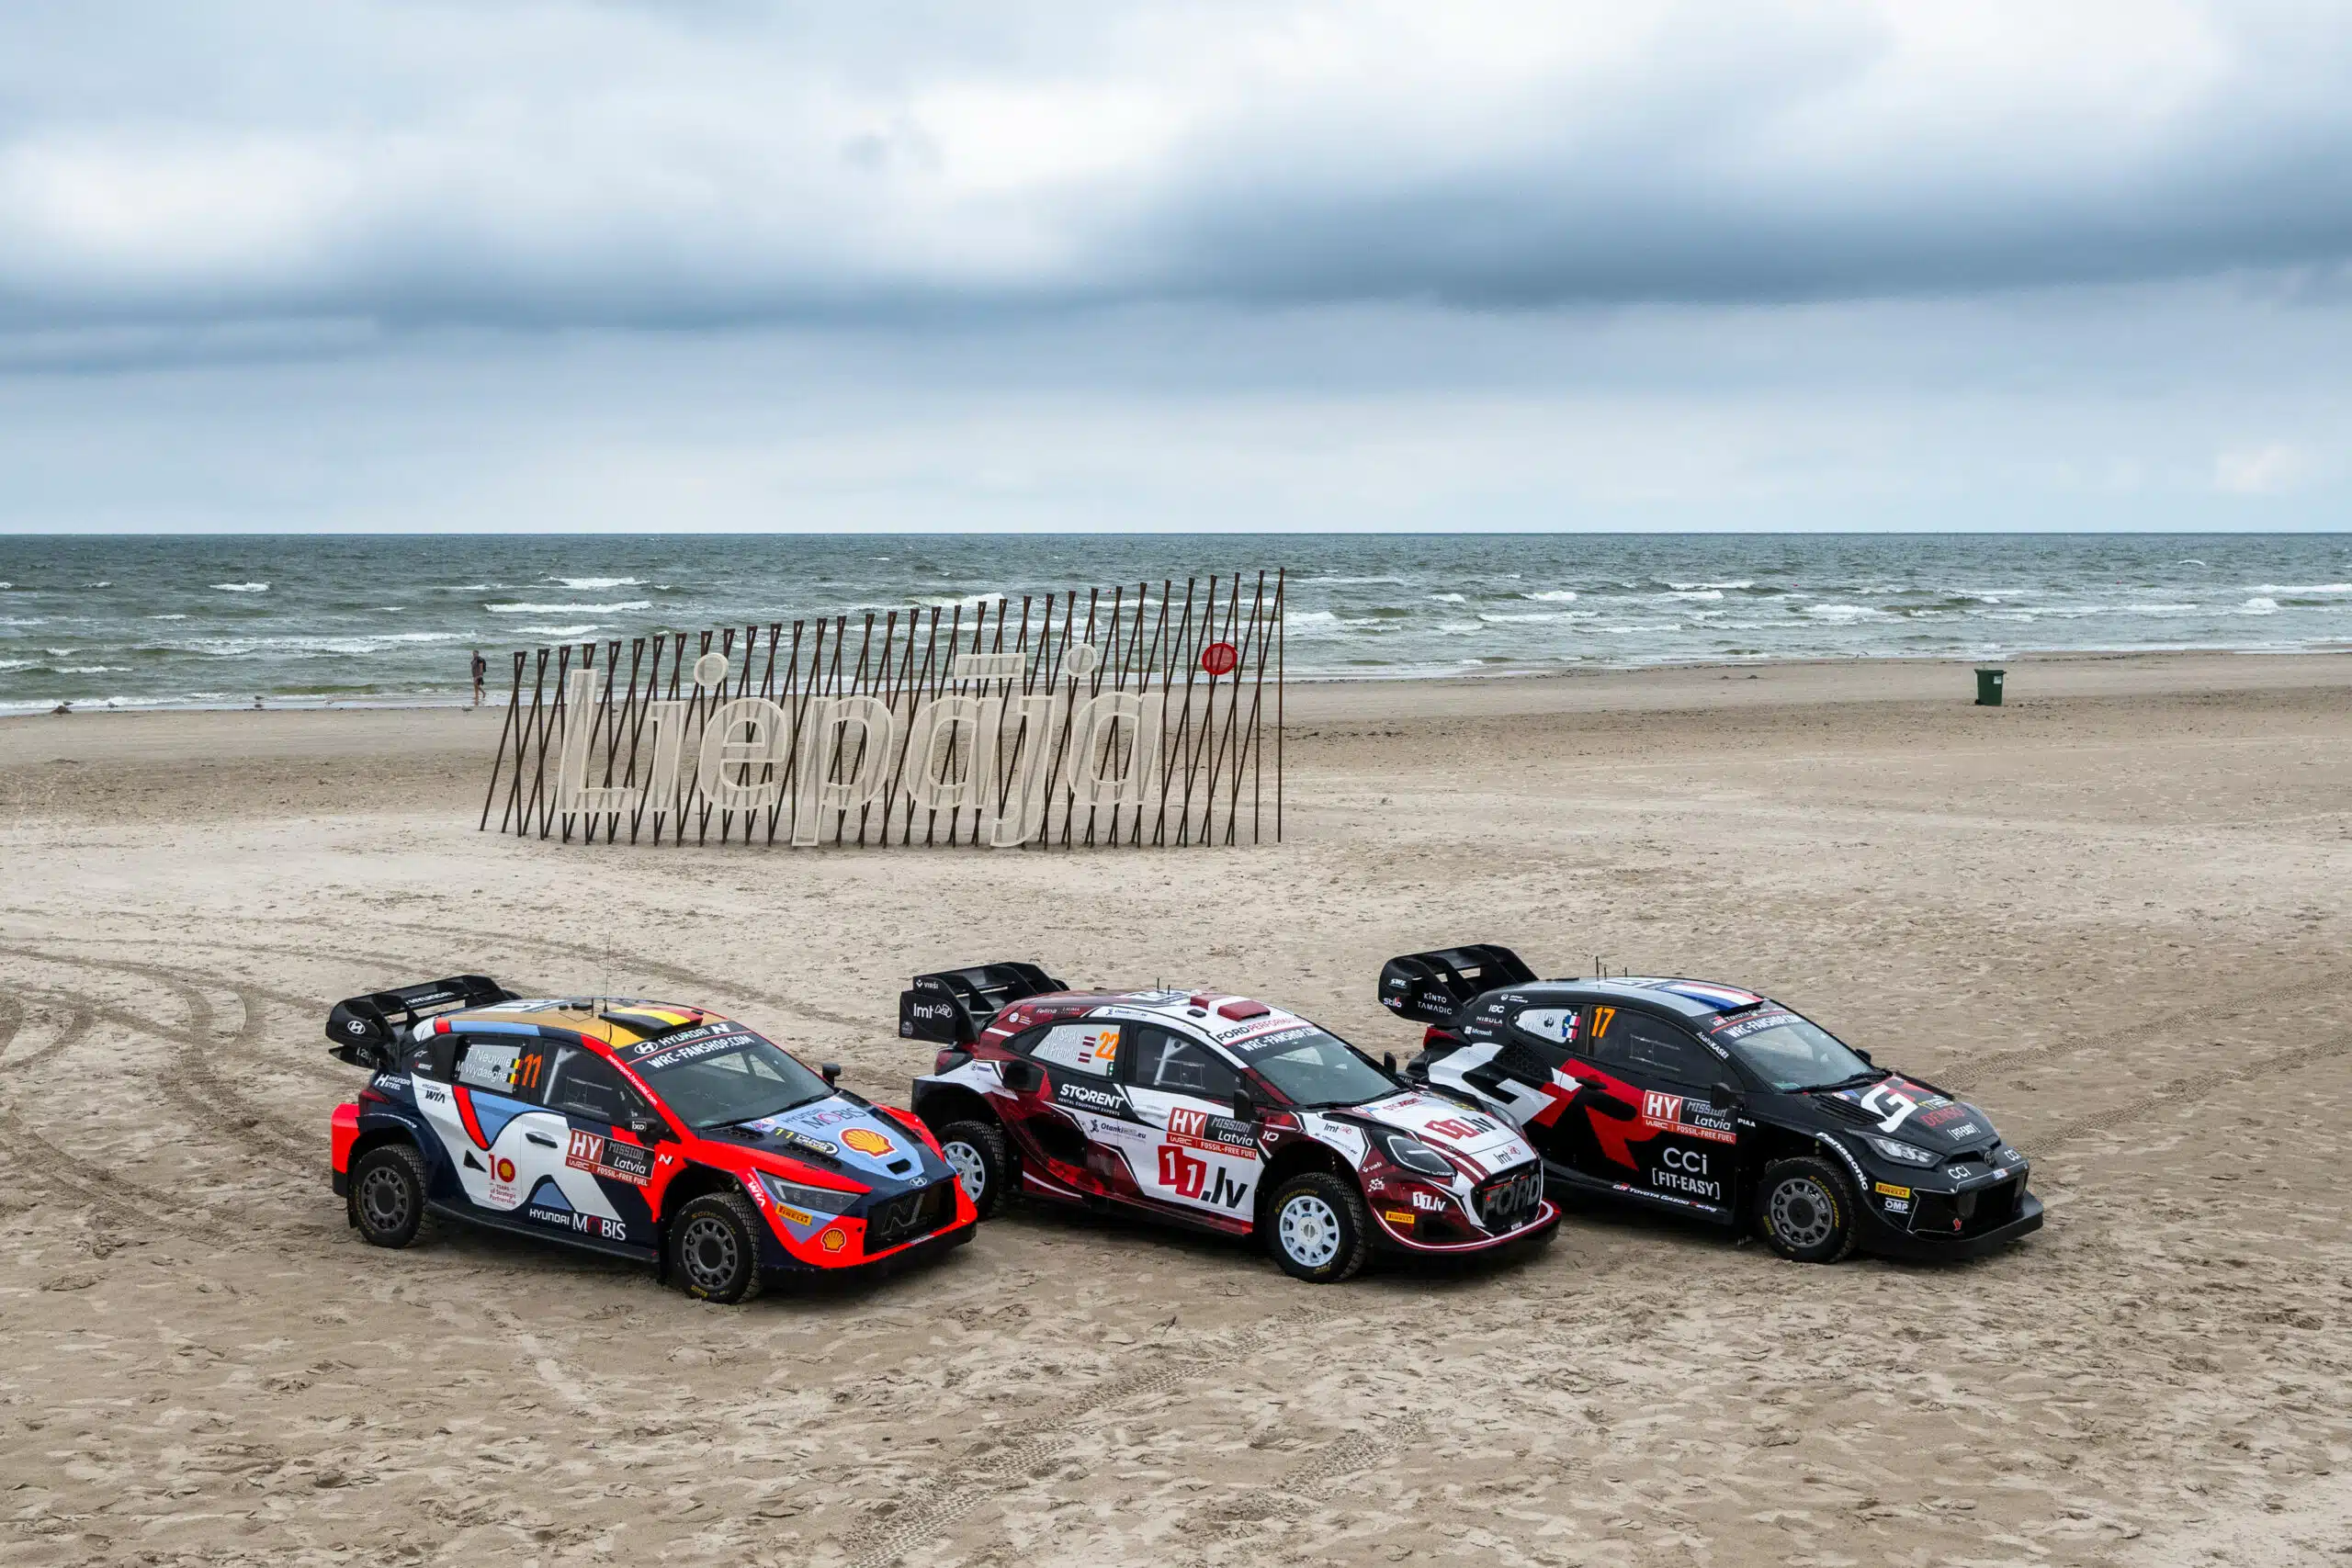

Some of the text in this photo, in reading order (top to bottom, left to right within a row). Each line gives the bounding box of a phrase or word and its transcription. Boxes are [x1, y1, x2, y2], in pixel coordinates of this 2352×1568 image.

[555, 643, 1164, 847] Liepāja
[913, 1003, 933, 1019] lmt
[1384, 997, 1402, 1008] Stilo
[1417, 1001, 1453, 1015] TAMADIC
[1476, 1016, 1503, 1024] NISULA
[1591, 1007, 1616, 1039] 17
[658, 1028, 710, 1046] HYUNDAI
[1216, 1026, 1250, 1042] FORD
[647, 1034, 755, 1068] WRC-FANSHOP.COM
[1095, 1031, 1120, 1060] 22
[476, 1050, 513, 1067] Neuville
[522, 1054, 542, 1089] 11
[606, 1055, 658, 1106] motorsport.hyundai.com
[384, 1081, 401, 1091] STEEL
[388, 1076, 412, 1087] HYUNDAI
[1060, 1084, 1124, 1110] STORENT
[1647, 1094, 1679, 1120] HY
[800, 1107, 866, 1130] MOBIS
[1171, 1109, 1204, 1135] HY
[1211, 1116, 1251, 1133] MISSION
[1694, 1114, 1731, 1131] Latvia
[1737, 1117, 1757, 1127] PIAA
[1218, 1131, 1253, 1146] Latvia
[1677, 1125, 1716, 1140] FOSSIL-FREE
[1717, 1133, 1734, 1143] FUEL
[571, 1134, 601, 1160] HY
[608, 1142, 645, 1160] MISSION
[1201, 1141, 1239, 1156] FOSSIL-FREE
[1240, 1149, 1257, 1158] FUEL
[614, 1156, 646, 1174] Latvia
[1815, 1132, 1869, 1191] Panasonic
[597, 1166, 633, 1182] FOSSIL-FREE
[634, 1176, 648, 1186] FUEL
[1163, 1150, 1248, 1209] 11.lv
[1482, 1173, 1542, 1223] FORD
[1878, 1183, 1908, 1197] PIRELLI
[1629, 1188, 1660, 1199] TOYOTA
[1660, 1195, 1690, 1205] GAZOO
[1690, 1201, 1718, 1213] Racing
[1884, 1200, 1909, 1212] OMP
[778, 1205, 808, 1224] PIRELLI
[529, 1208, 627, 1241] HYUNDAI MOBIS
